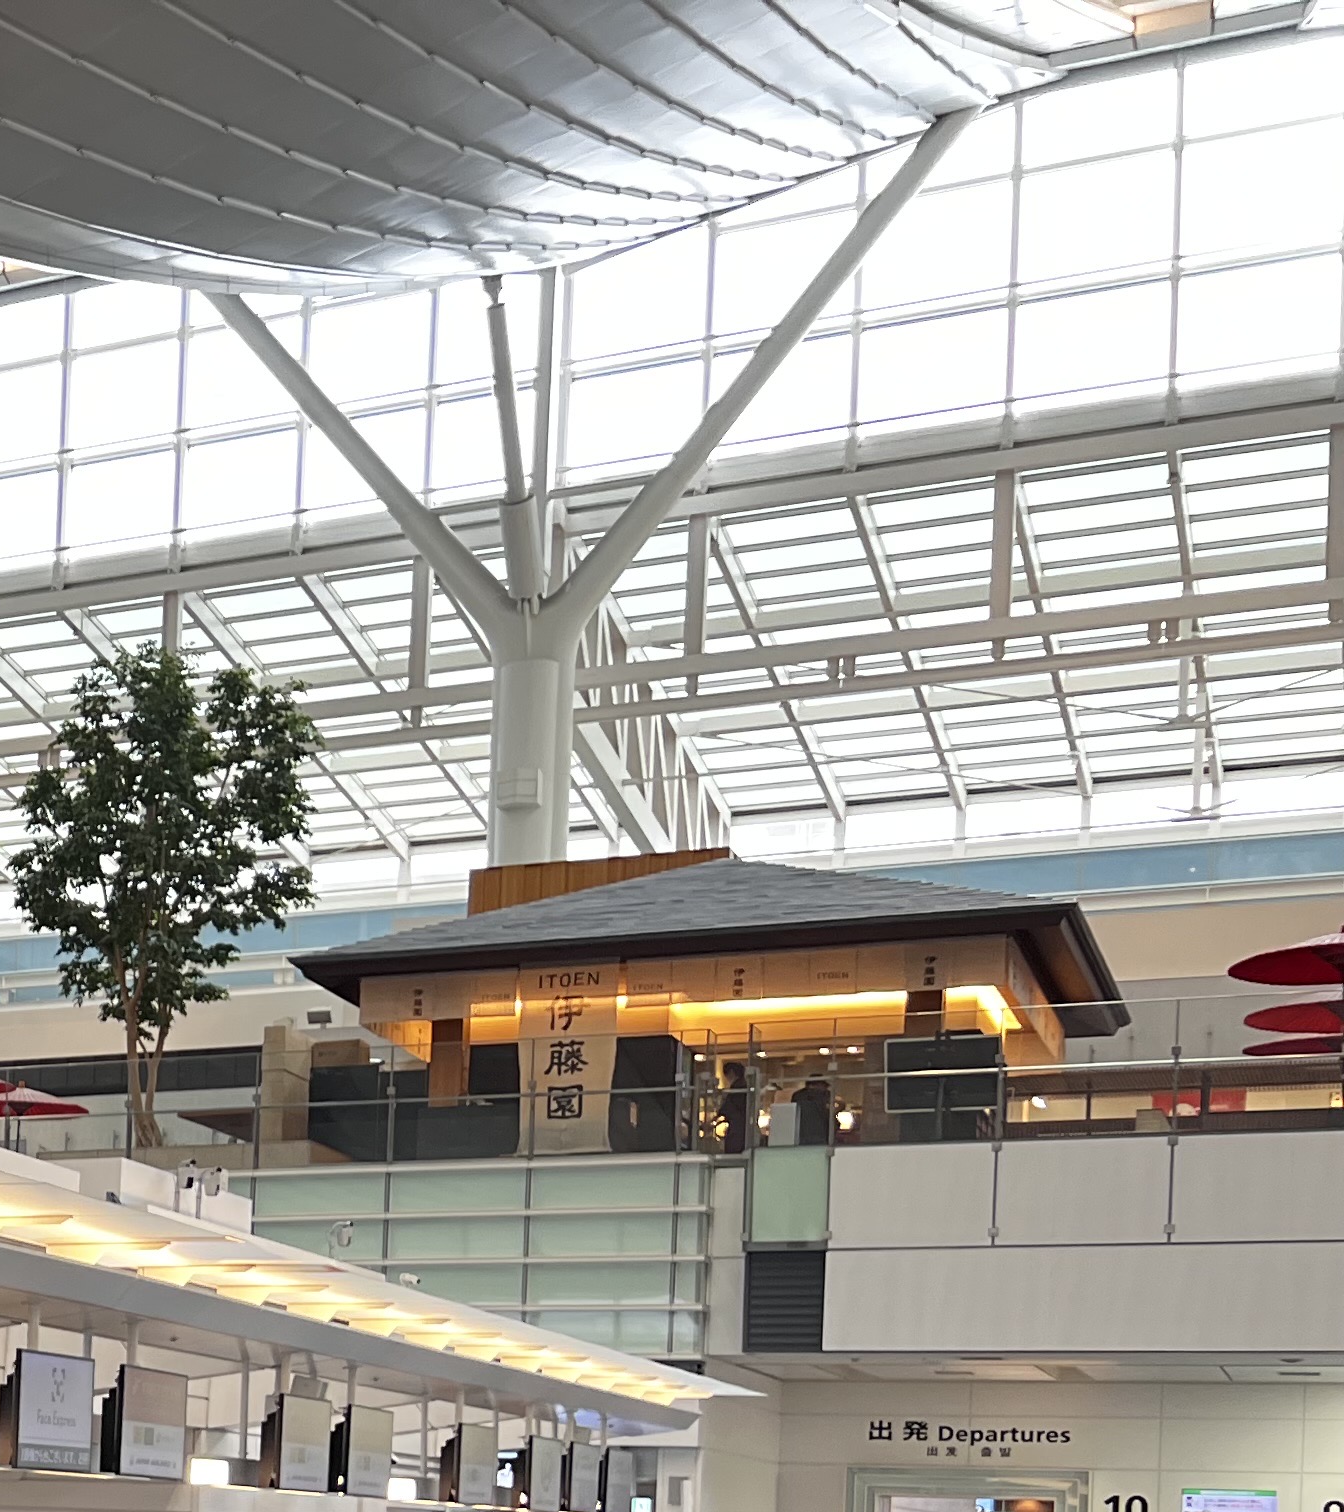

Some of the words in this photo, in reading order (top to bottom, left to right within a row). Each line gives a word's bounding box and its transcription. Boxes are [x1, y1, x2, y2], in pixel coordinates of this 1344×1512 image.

[538, 971, 600, 989] ITOEN
[544, 995, 589, 1119] 伊藤園
[868, 1420, 928, 1441] 出発
[938, 1425, 1071, 1446] Departures
